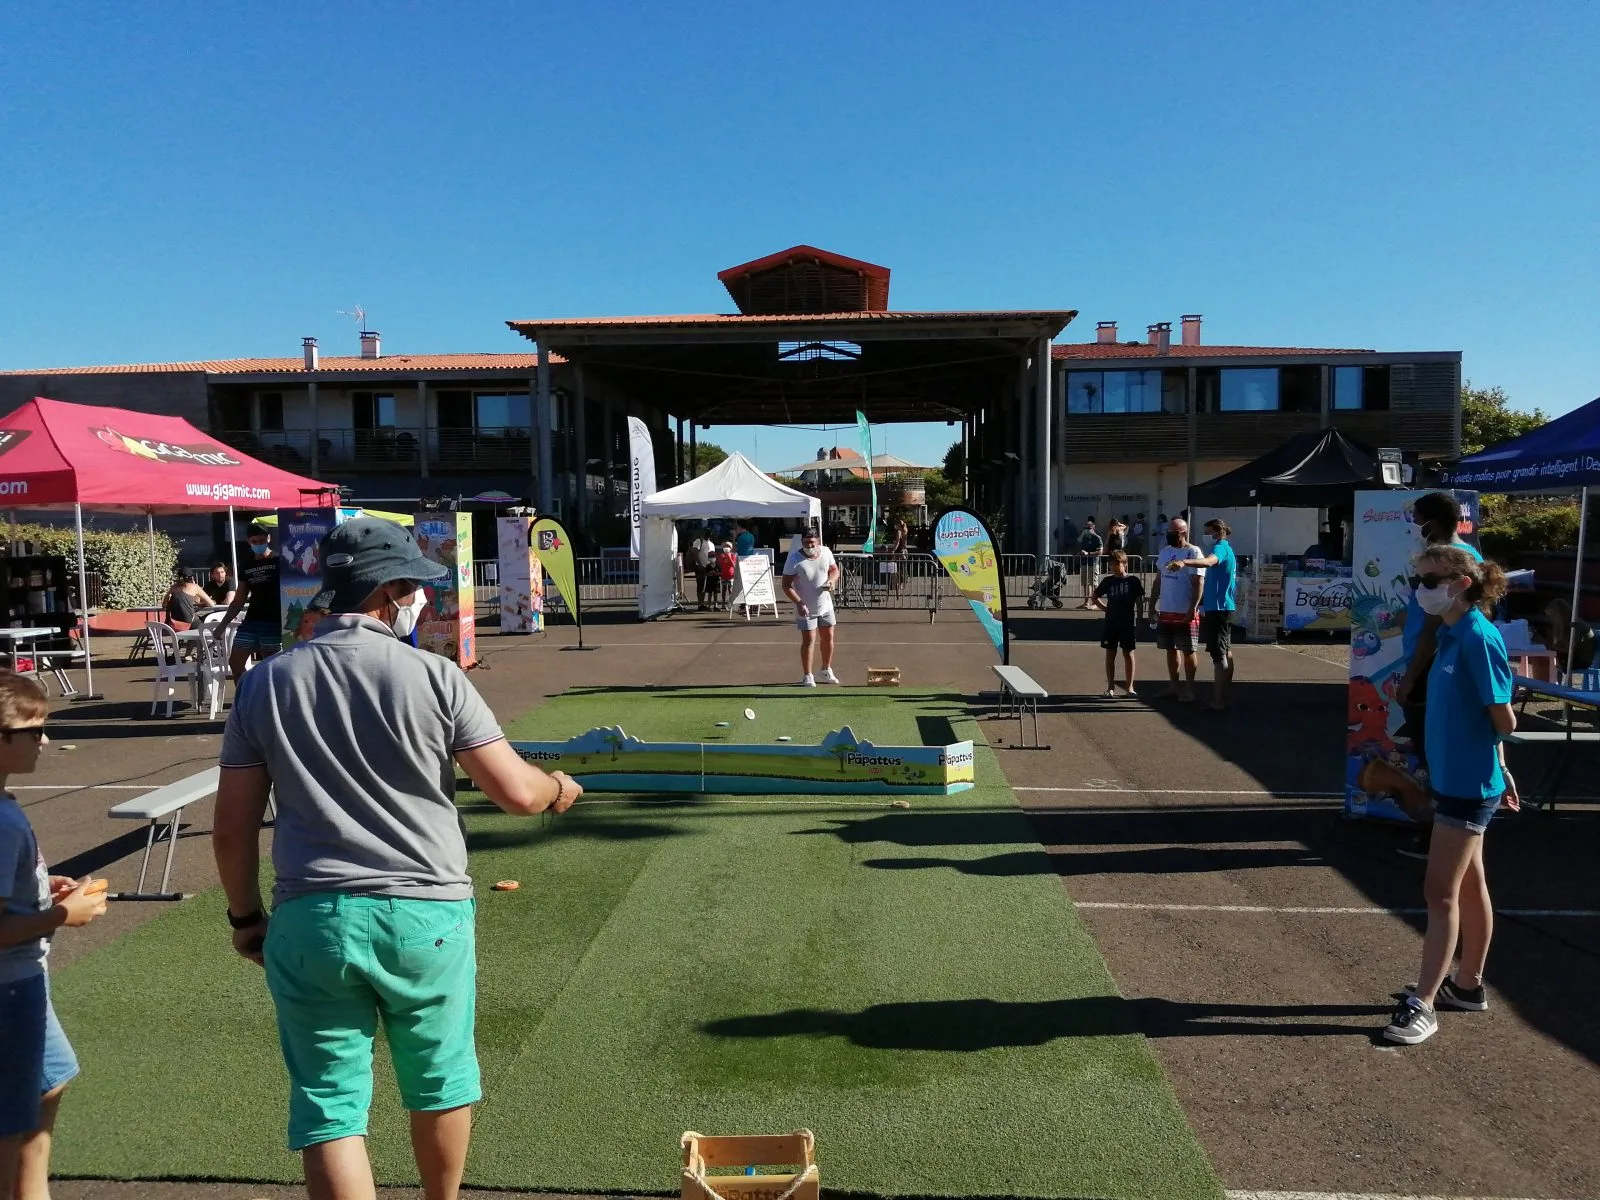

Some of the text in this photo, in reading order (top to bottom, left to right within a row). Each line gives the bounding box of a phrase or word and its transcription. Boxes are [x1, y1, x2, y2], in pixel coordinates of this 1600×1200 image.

[1495, 471, 1511, 484] pour
[1512, 463, 1539, 482] grandir
[1540, 458, 1578, 477] intelligent
[186, 482, 271, 500] www.gigamic.com
